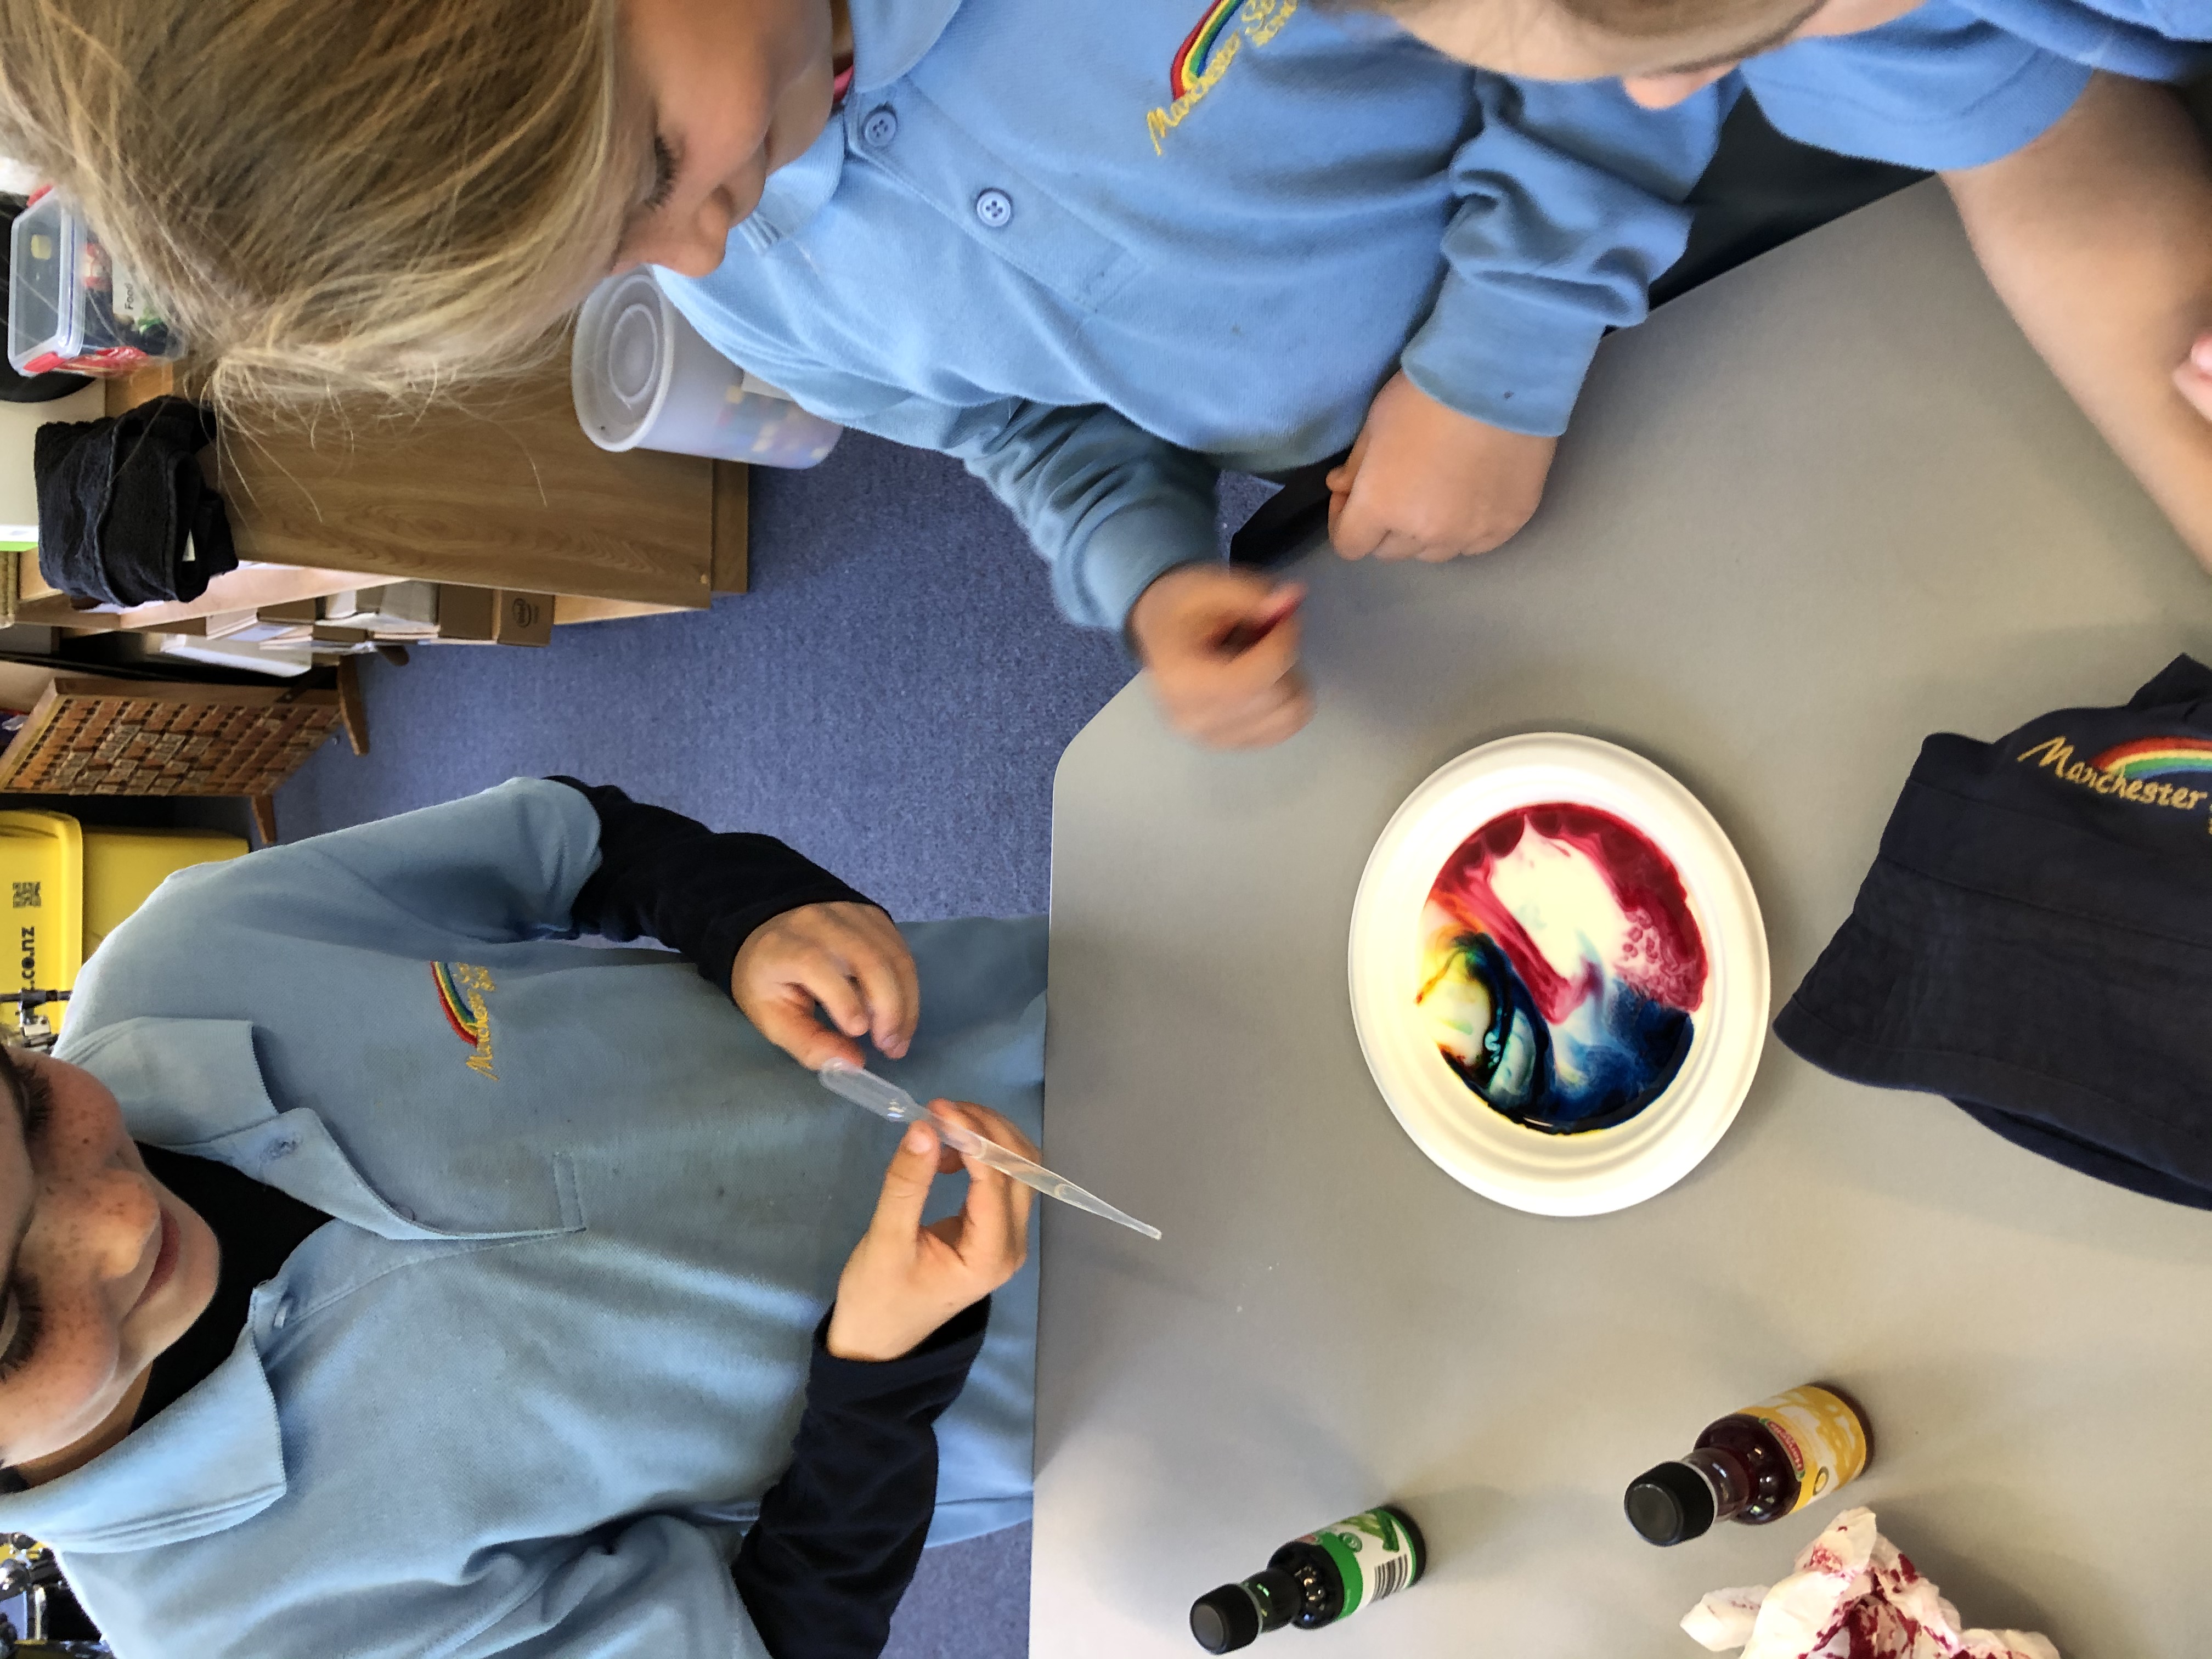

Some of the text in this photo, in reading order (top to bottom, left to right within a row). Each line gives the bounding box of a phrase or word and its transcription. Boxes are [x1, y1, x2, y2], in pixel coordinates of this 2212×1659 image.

[124, 282, 134, 311] Food
[2017, 736, 2208, 810] Manchester
[21, 926, 35, 991] .co.nz
